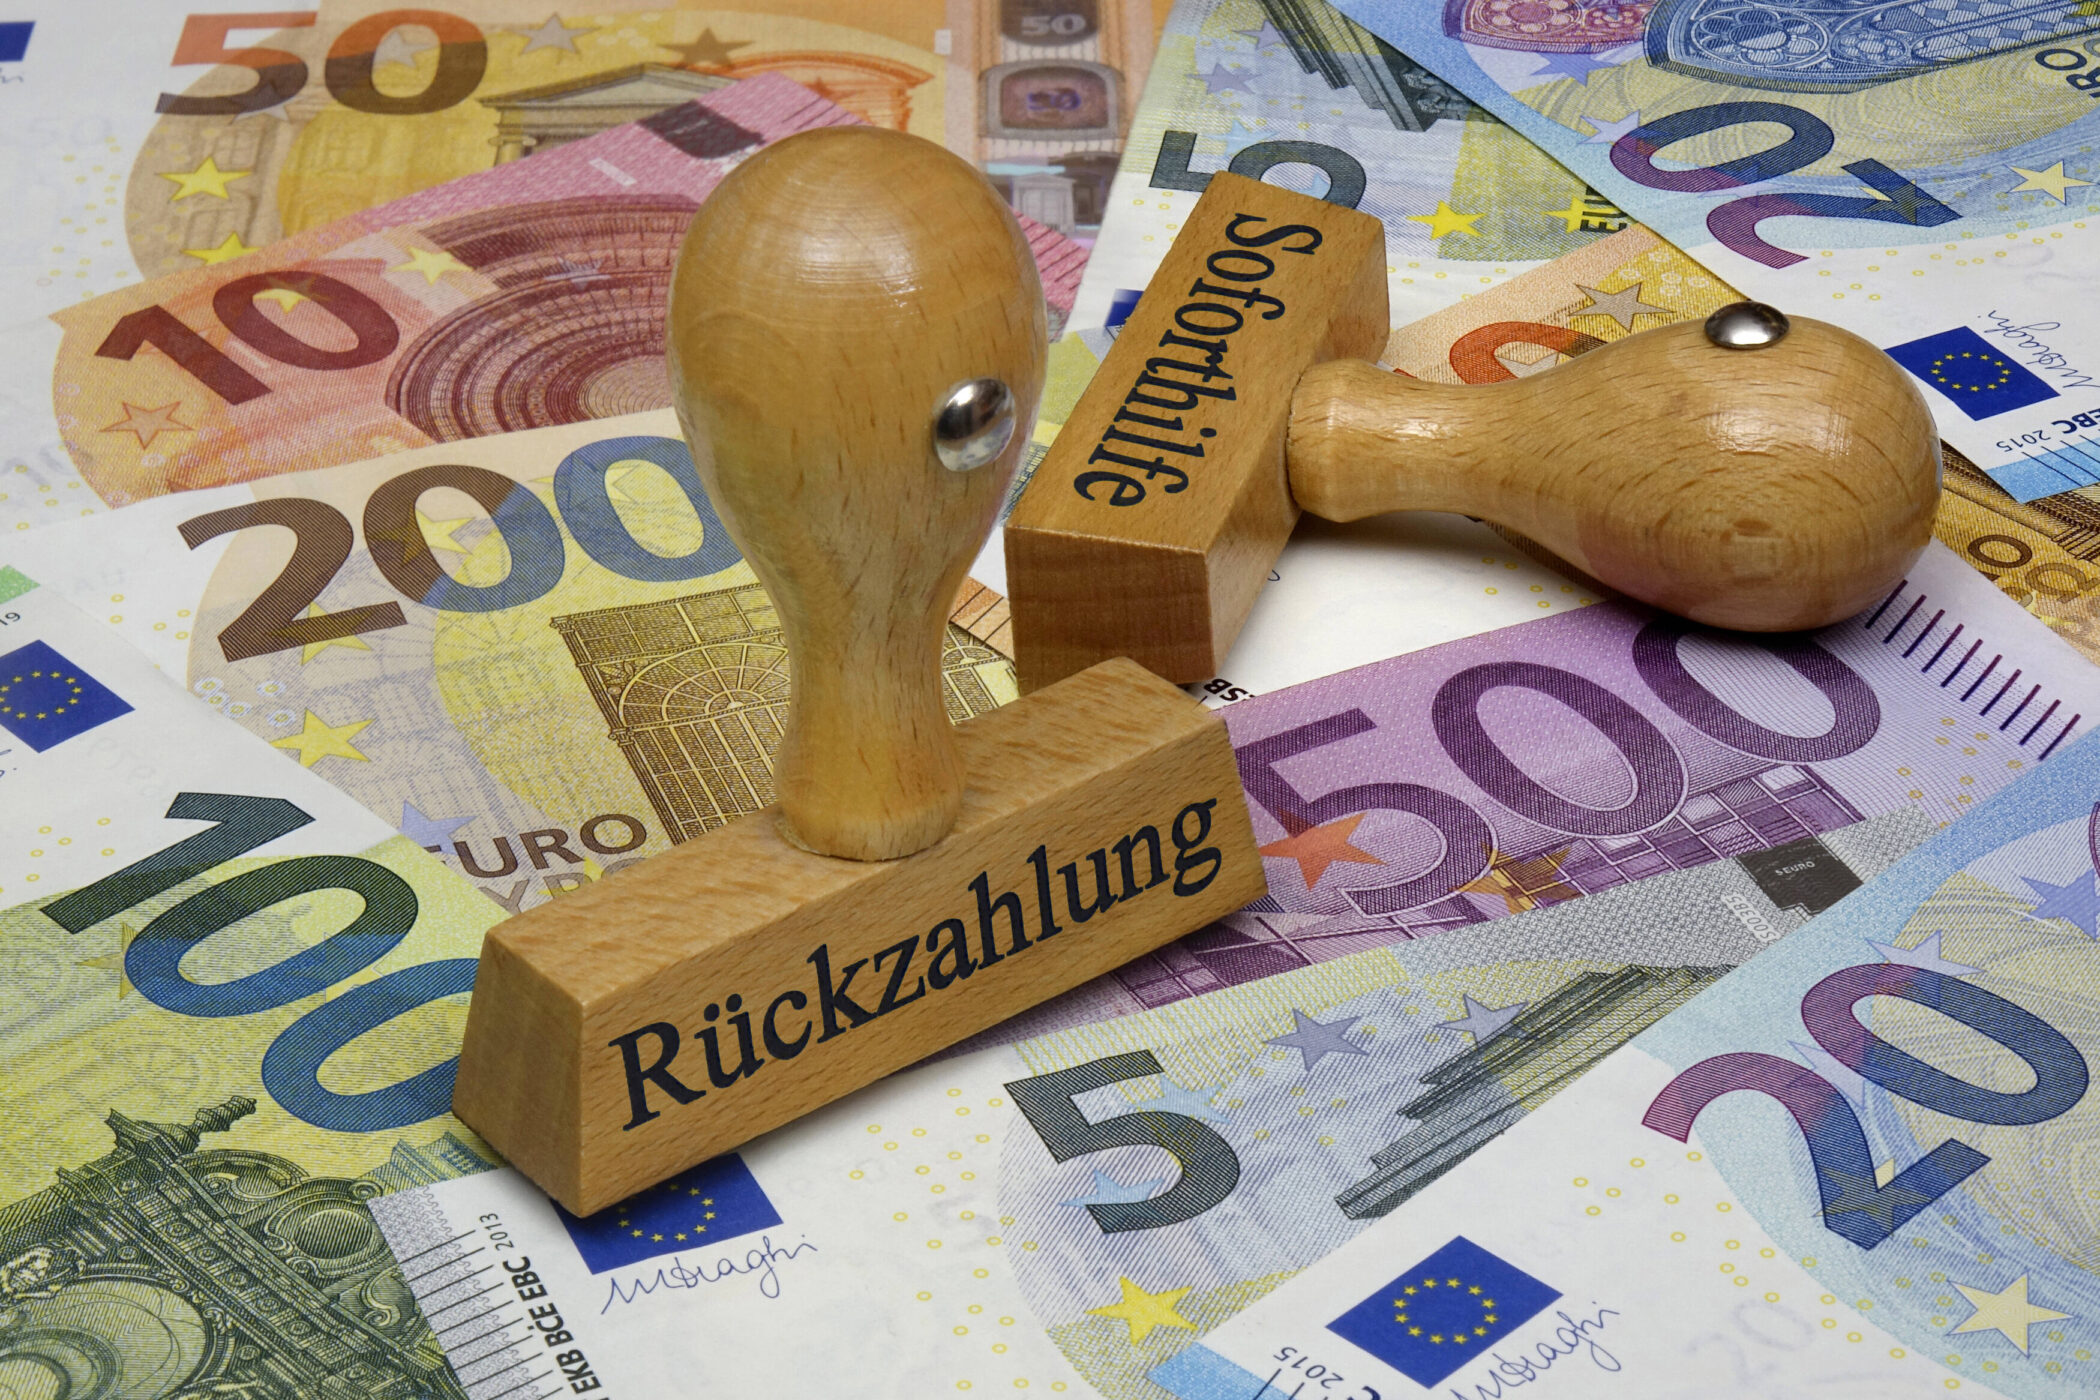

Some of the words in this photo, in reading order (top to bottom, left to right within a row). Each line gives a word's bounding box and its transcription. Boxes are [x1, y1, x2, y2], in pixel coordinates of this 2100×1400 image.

[155, 10, 488, 116] 50
[1021, 13, 1086, 36] 50
[1609, 101, 1962, 269] 20
[94, 269, 400, 406] 10
[1074, 213, 1323, 506] Soforthilfe
[1996, 429, 2051, 452] 2015
[177, 436, 742, 663] 200
[1234, 620, 1881, 916] 500
[424, 813, 647, 879] URO
[40, 791, 484, 1133] 100
[609, 797, 1221, 1129] Rückzahlung
[1003, 1048, 1240, 1235] 5
[1642, 962, 2090, 1250] 20
[479, 1212, 515, 1252] 2013
[502, 1255, 548, 1302] EBC
[556, 1349, 602, 1394] EKB
[1273, 1346, 1344, 1390] 2015
